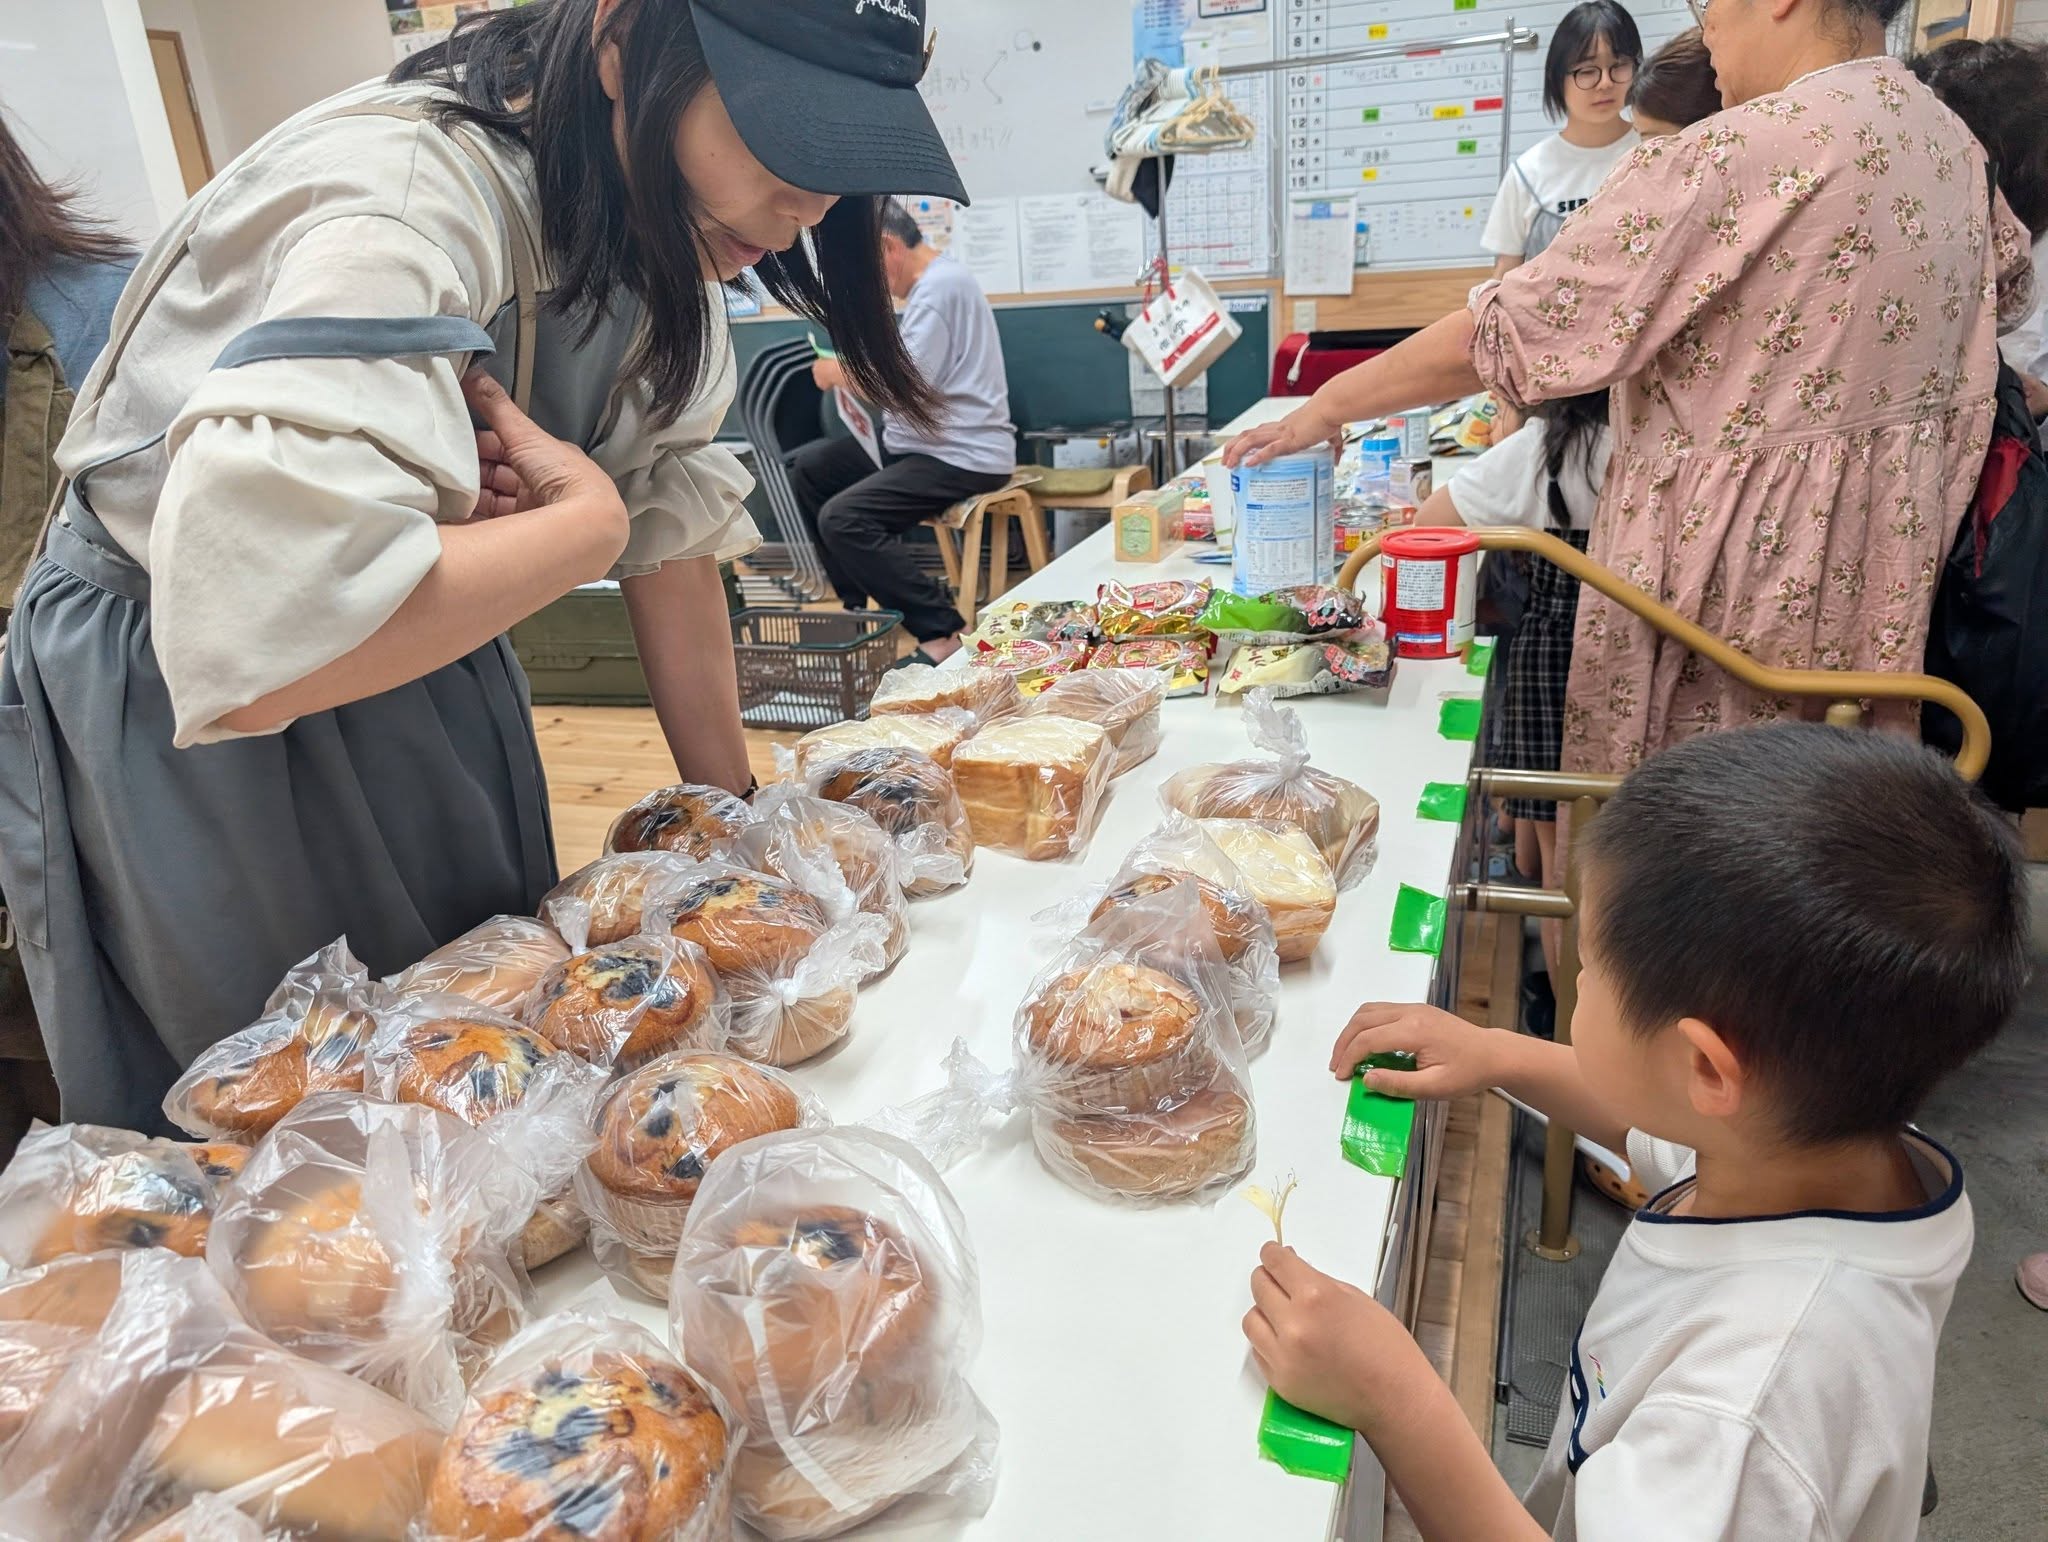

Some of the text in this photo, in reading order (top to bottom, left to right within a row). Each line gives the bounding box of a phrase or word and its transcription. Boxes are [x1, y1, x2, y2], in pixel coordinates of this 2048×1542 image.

[1293, 16, 1302, 27] 7
[1293, 36, 1302, 48] 8
[1291, 76, 1306, 88] 10
[1291, 97, 1305, 108] 11
[1291, 117, 1307, 129] 12
[1291, 137, 1306, 149] 13
[1291, 157, 1305, 168] 14
